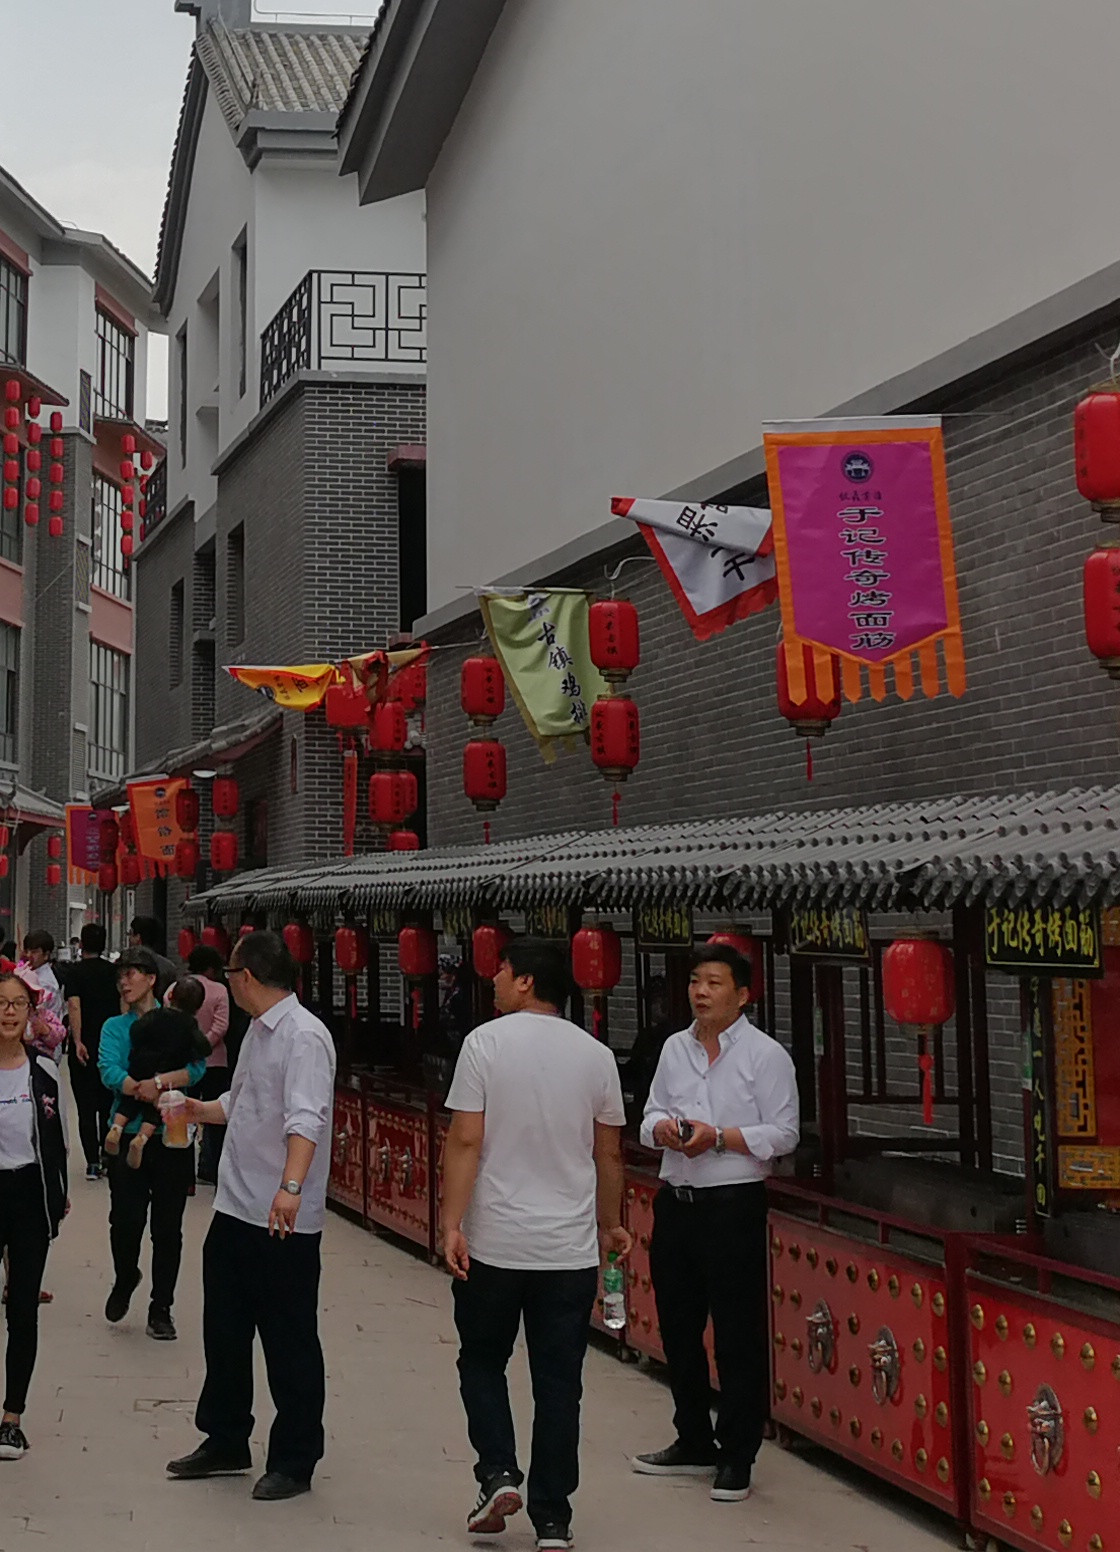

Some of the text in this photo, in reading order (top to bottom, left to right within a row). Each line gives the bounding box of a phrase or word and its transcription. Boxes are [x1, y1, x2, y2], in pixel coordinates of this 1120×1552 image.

[837, 506, 896, 649] 于记传奇烤面筋
[987, 905, 1094, 957] 于记传奇烤面筋
